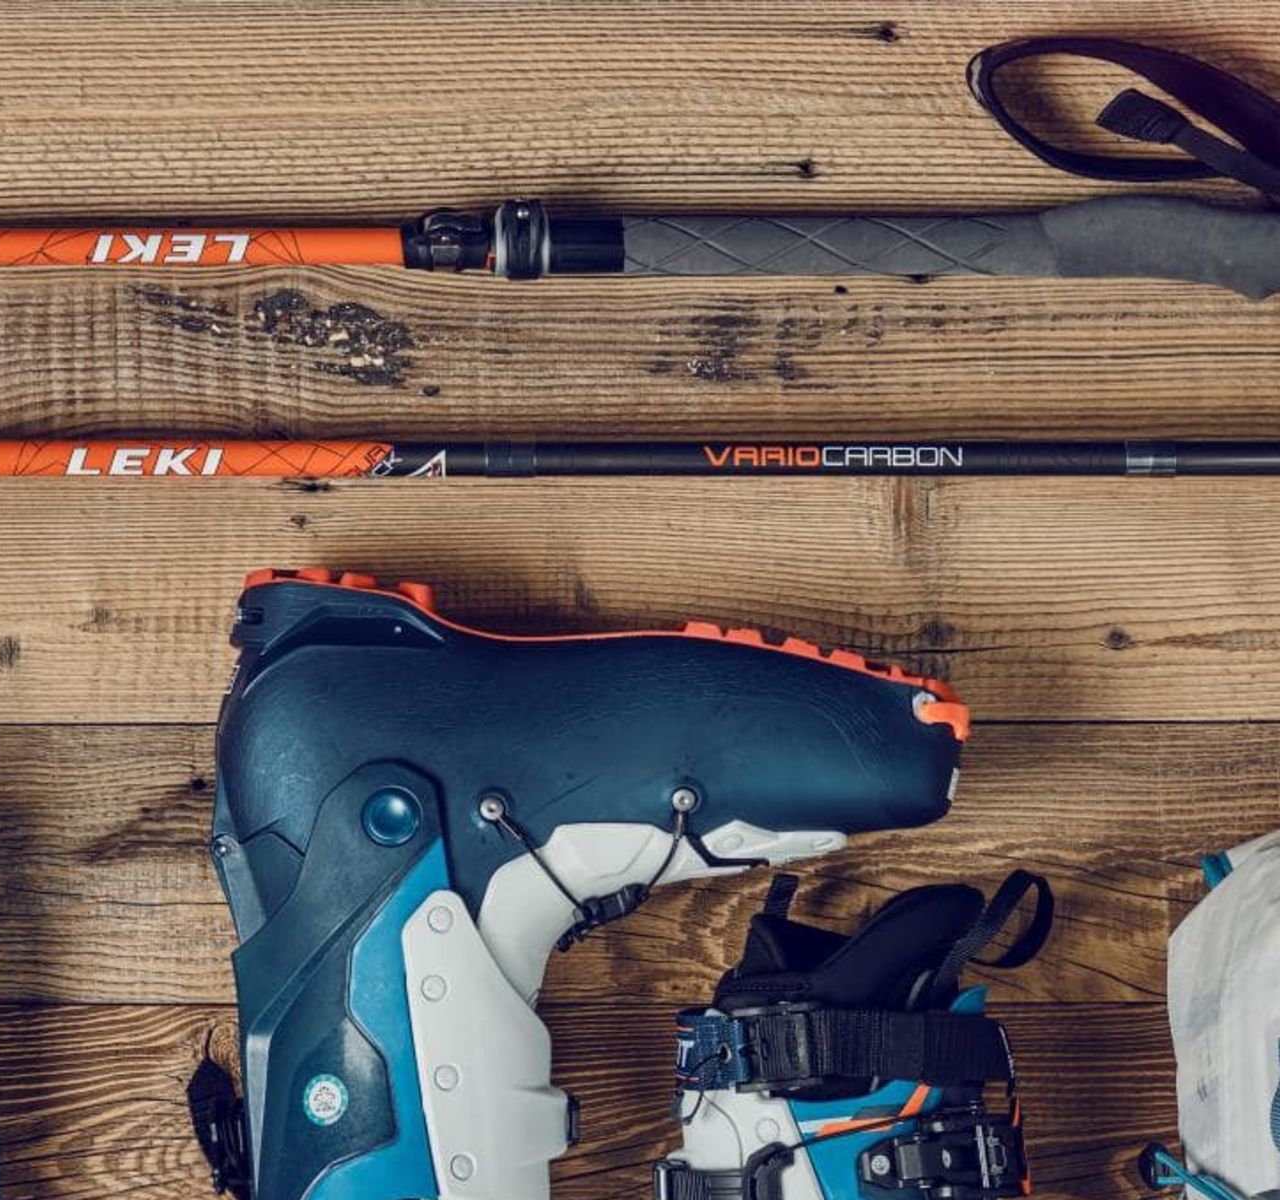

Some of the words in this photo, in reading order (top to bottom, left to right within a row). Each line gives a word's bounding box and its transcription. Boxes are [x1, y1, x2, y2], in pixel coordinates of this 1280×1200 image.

[92, 234, 251, 263] LEKI
[67, 448, 223, 475] LEKI
[703, 445, 964, 468] VARIOCARBON
